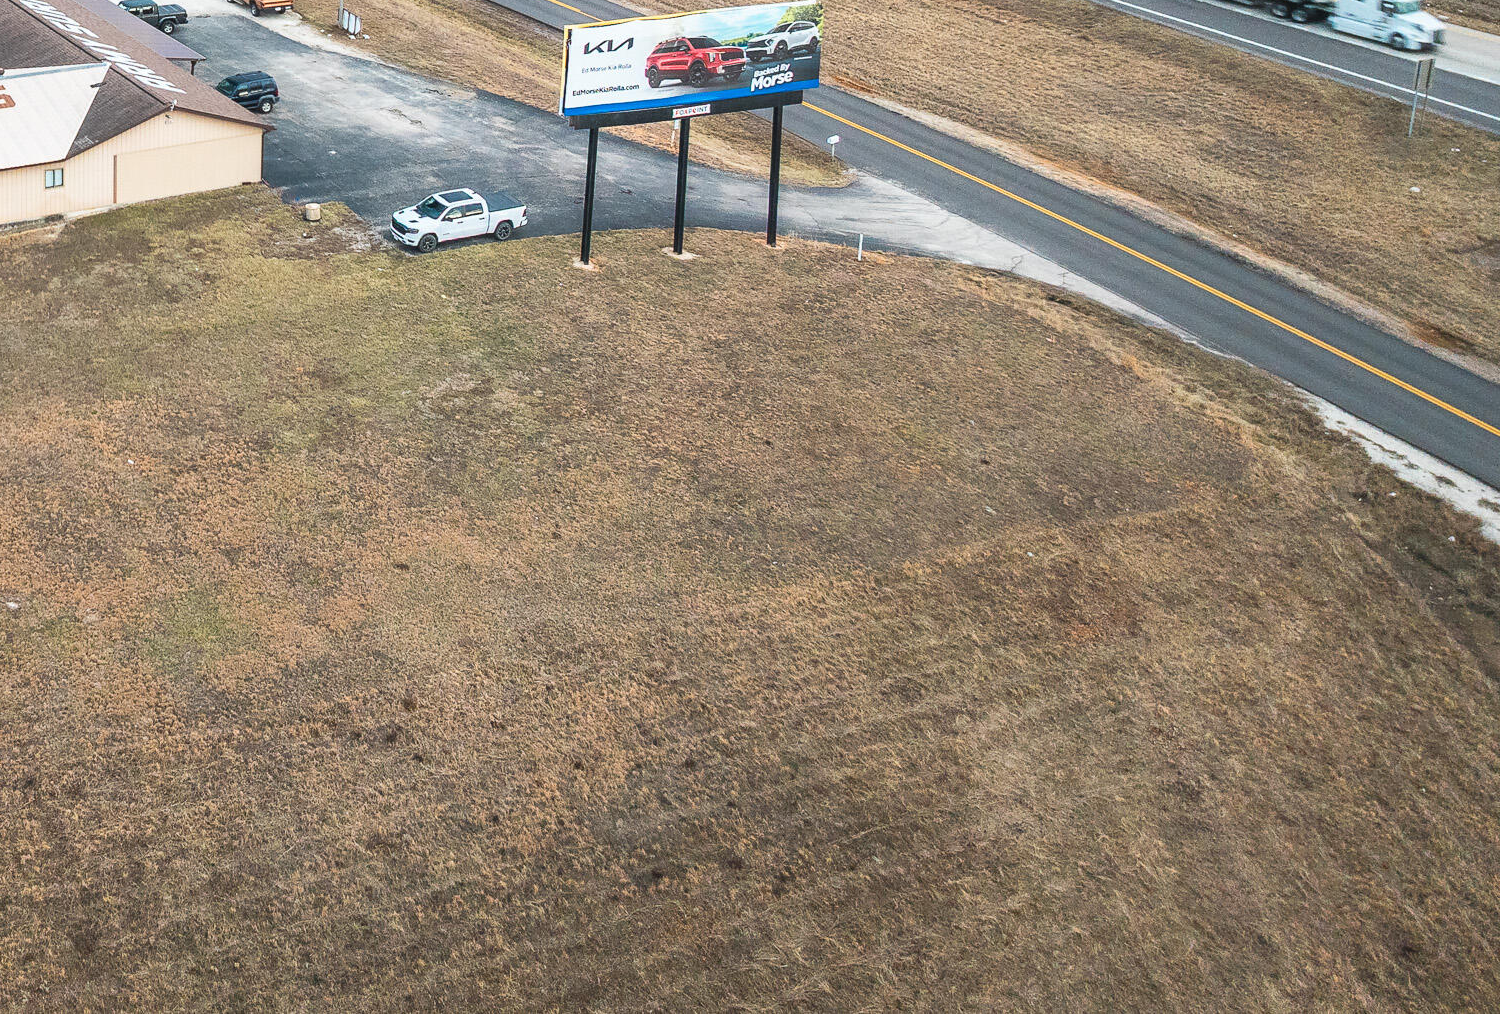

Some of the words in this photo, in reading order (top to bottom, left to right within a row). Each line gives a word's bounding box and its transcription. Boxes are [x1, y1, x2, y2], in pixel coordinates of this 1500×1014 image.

[754, 64, 780, 78] Backed
[750, 70, 794, 92] Morse
[572, 84, 640, 97] EdMorseKiaRolla.com
